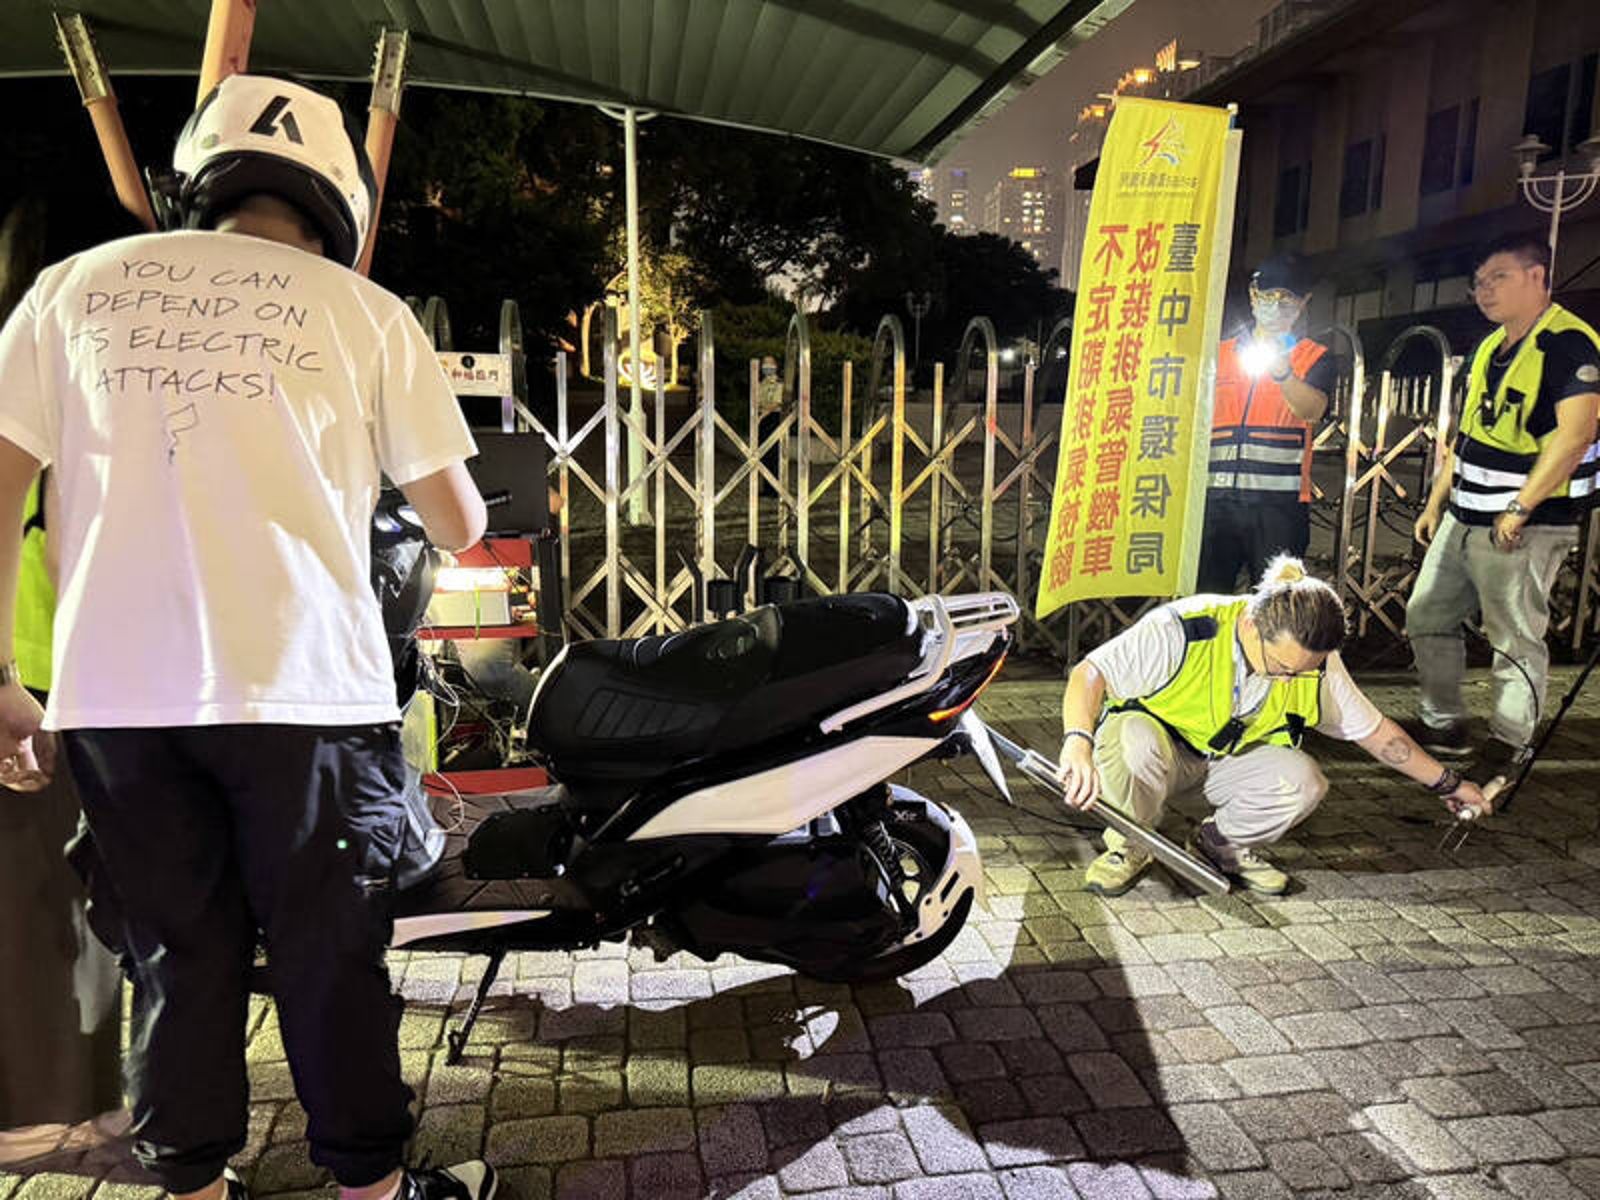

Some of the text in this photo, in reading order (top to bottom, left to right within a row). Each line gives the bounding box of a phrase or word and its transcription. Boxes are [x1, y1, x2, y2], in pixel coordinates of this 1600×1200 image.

[122, 260, 292, 290] YOU CAN
[86, 290, 308, 329] DEPEND ON
[129, 325, 324, 373] ELECTRIC
[96, 368, 276, 402] ATTACKS!
